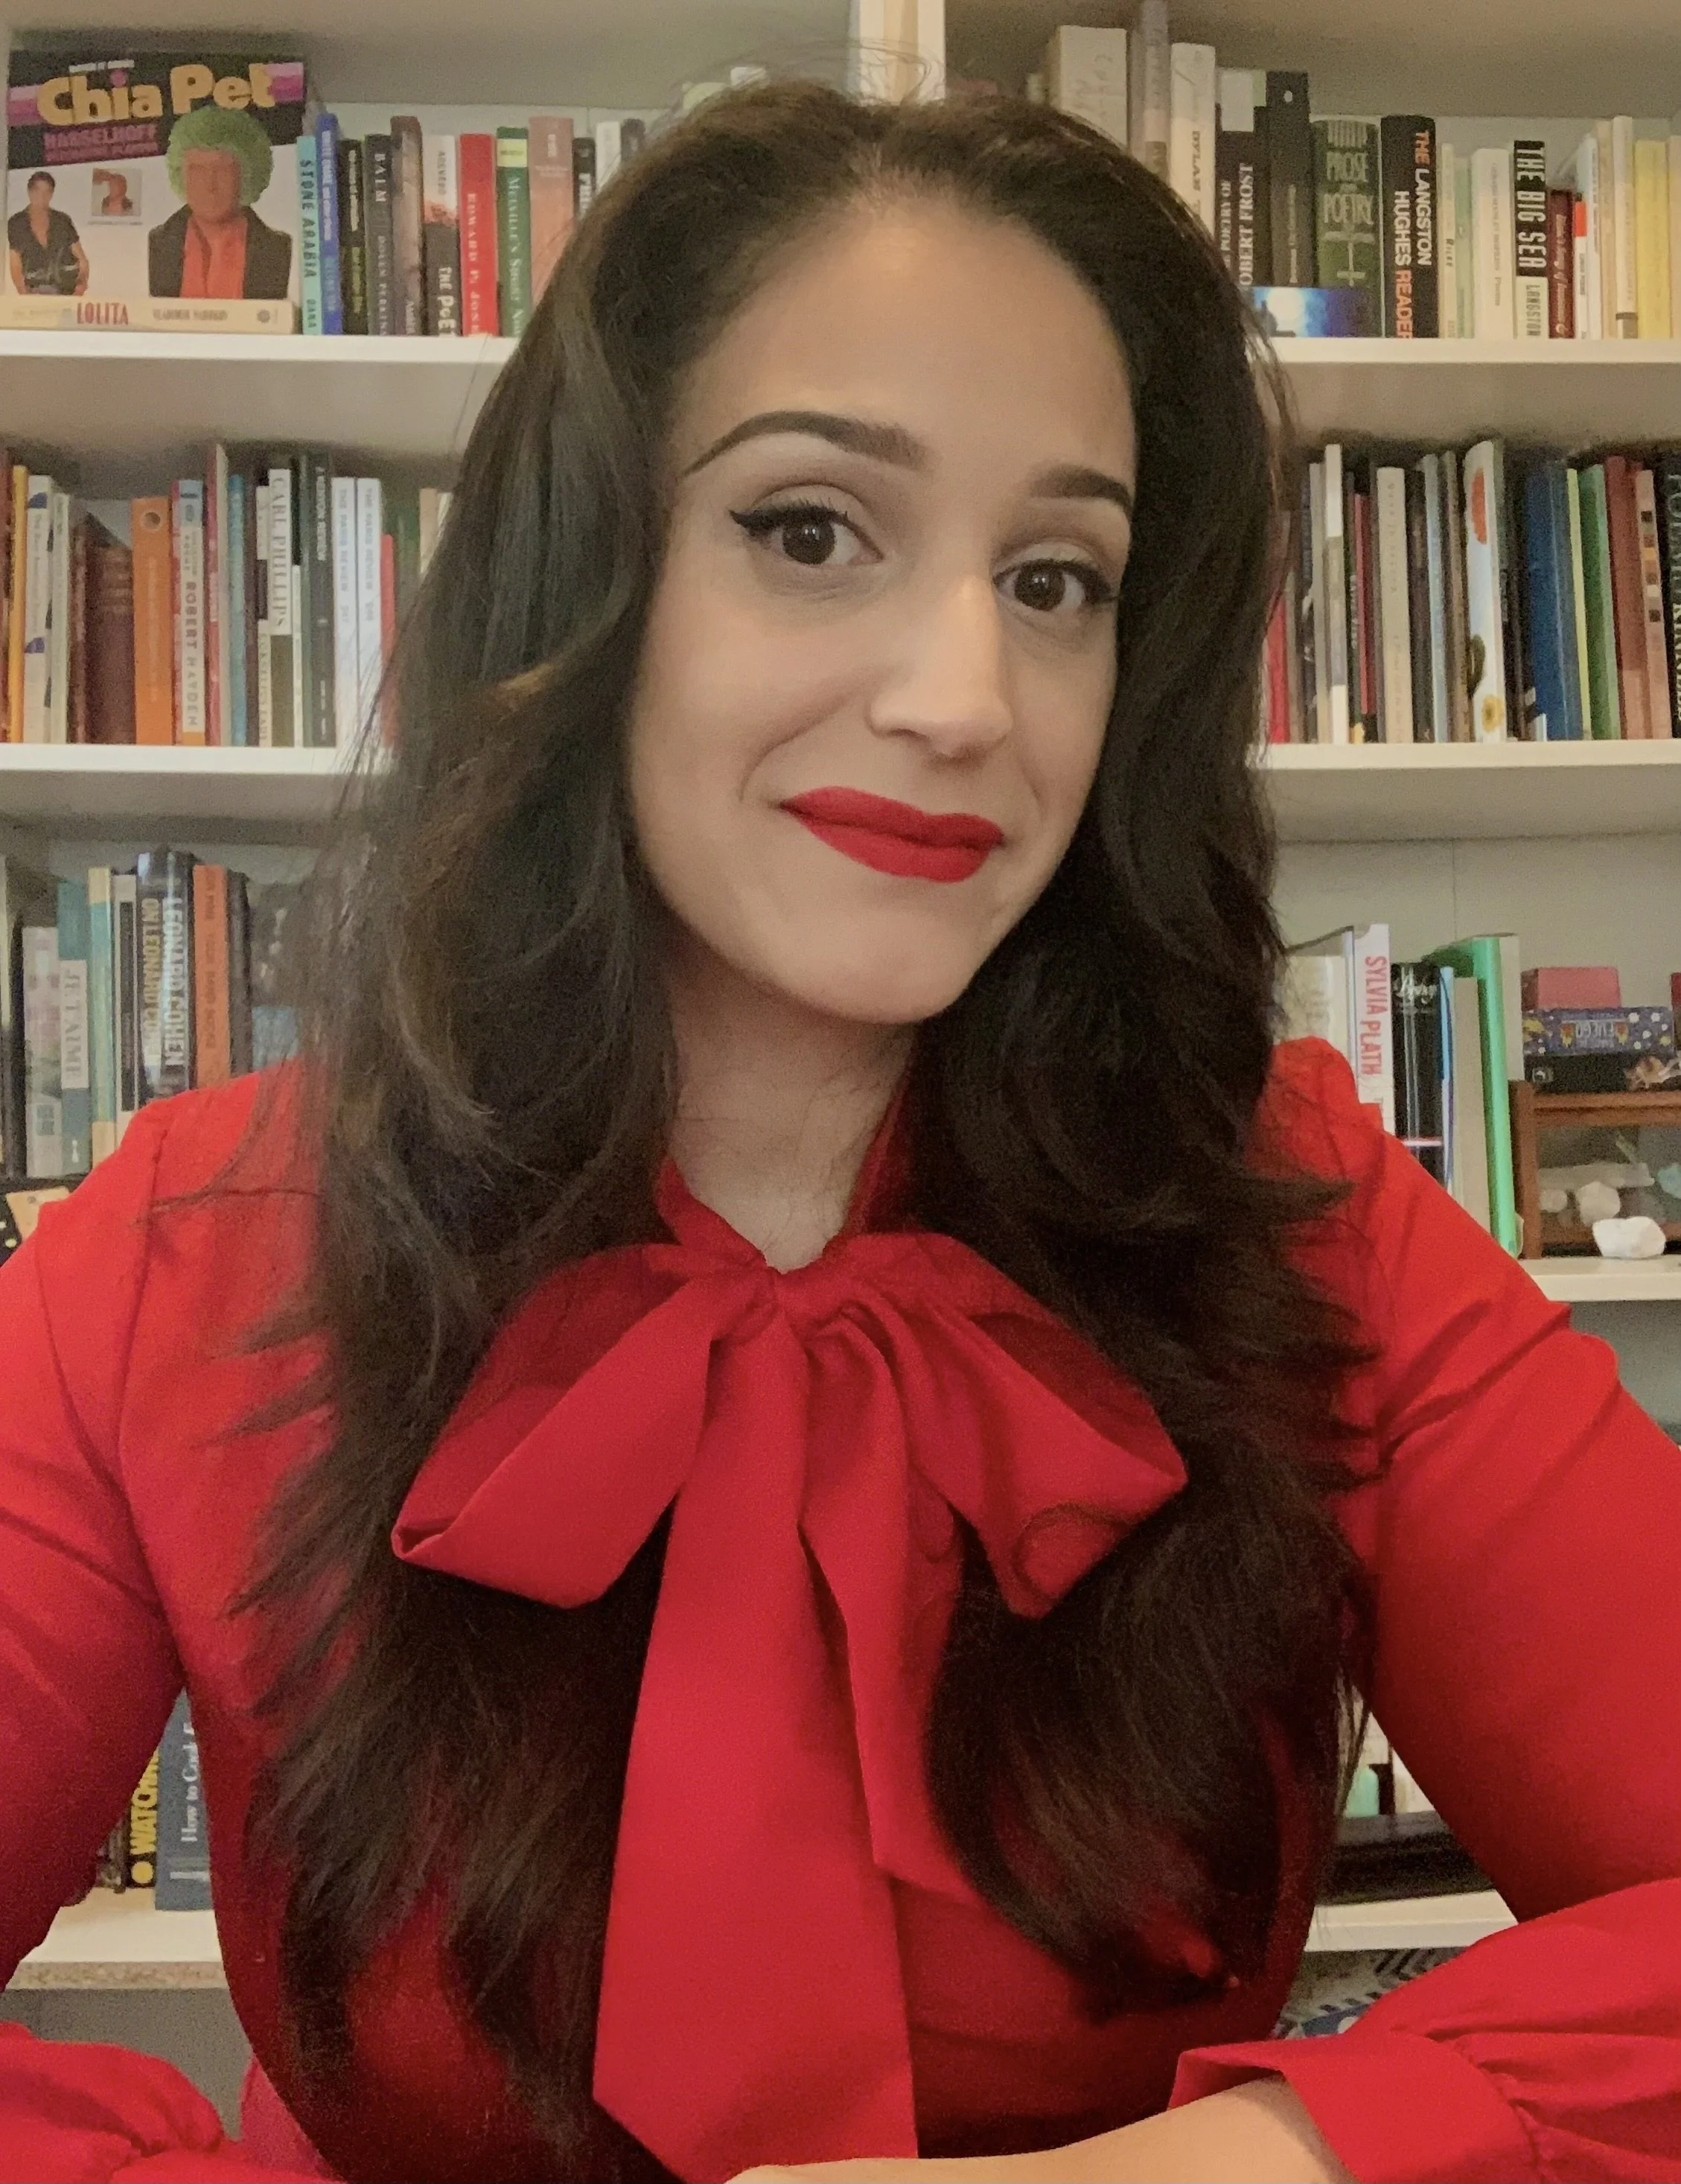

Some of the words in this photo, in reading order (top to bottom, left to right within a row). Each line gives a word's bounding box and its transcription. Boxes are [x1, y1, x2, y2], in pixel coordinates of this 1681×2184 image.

[37, 69, 163, 126] Chia
[170, 63, 276, 115] Pet
[1415, 131, 1430, 165] THE
[1517, 147, 1545, 182] THE
[300, 159, 316, 211] STONE
[1239, 162, 1253, 221] FROST
[1517, 191, 1546, 223] BIG
[1394, 191, 1411, 265] HUGHES
[1415, 169, 1432, 265] LANGSTON
[302, 217, 318, 278] ARABIA
[1239, 225, 1253, 286] OBERT
[1517, 232, 1547, 268] SEA
[438, 267, 453, 290] THE
[76, 302, 129, 325] LOLITA
[185, 581, 197, 649] ROBERT
[186, 656, 198, 727] HAYDEN
[163, 898, 185, 992] LEONARD
[1365, 955, 1388, 1015] SYLVIA
[163, 996, 185, 1066] COHEN
[1359, 1019, 1382, 1076] PLATH
[185, 1785, 199, 1801] to
[180, 1804, 199, 1842] How
